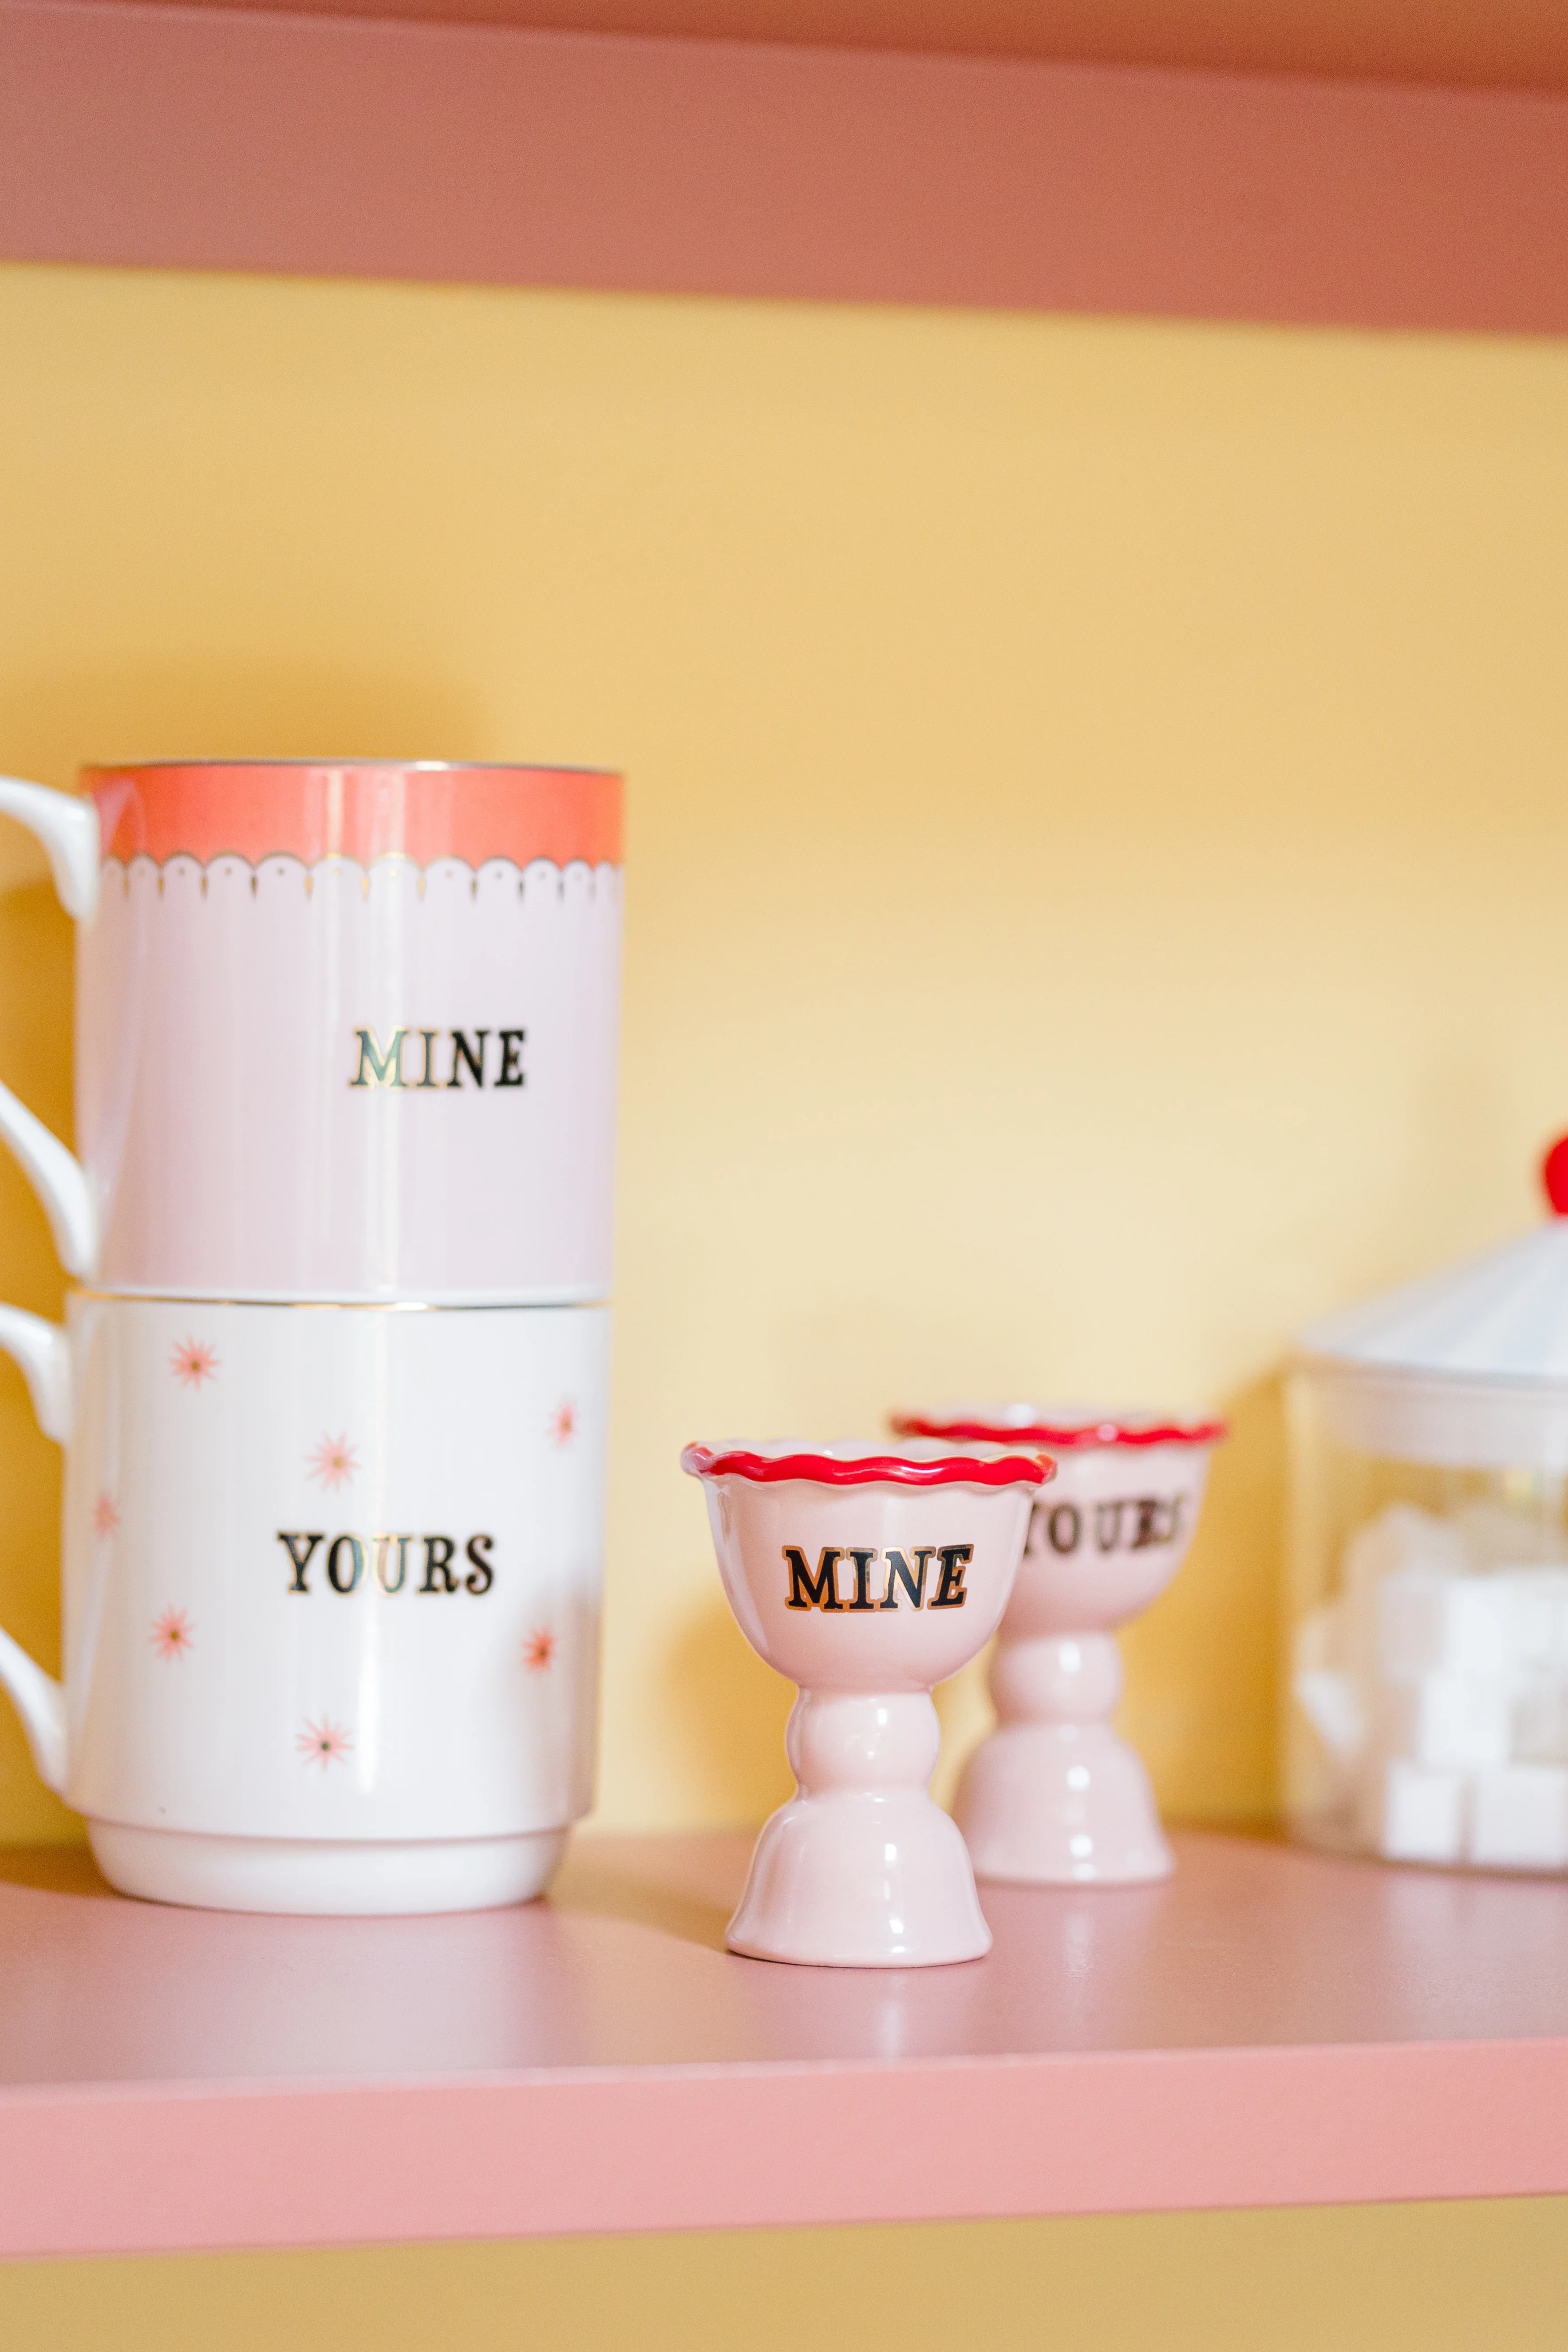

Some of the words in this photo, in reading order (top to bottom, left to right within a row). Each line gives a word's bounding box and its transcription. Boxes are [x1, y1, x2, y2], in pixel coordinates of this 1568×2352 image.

[350, 1027, 526, 1089] MINE
[276, 1531, 496, 1596] YOURS
[782, 1544, 974, 1612] MINE
